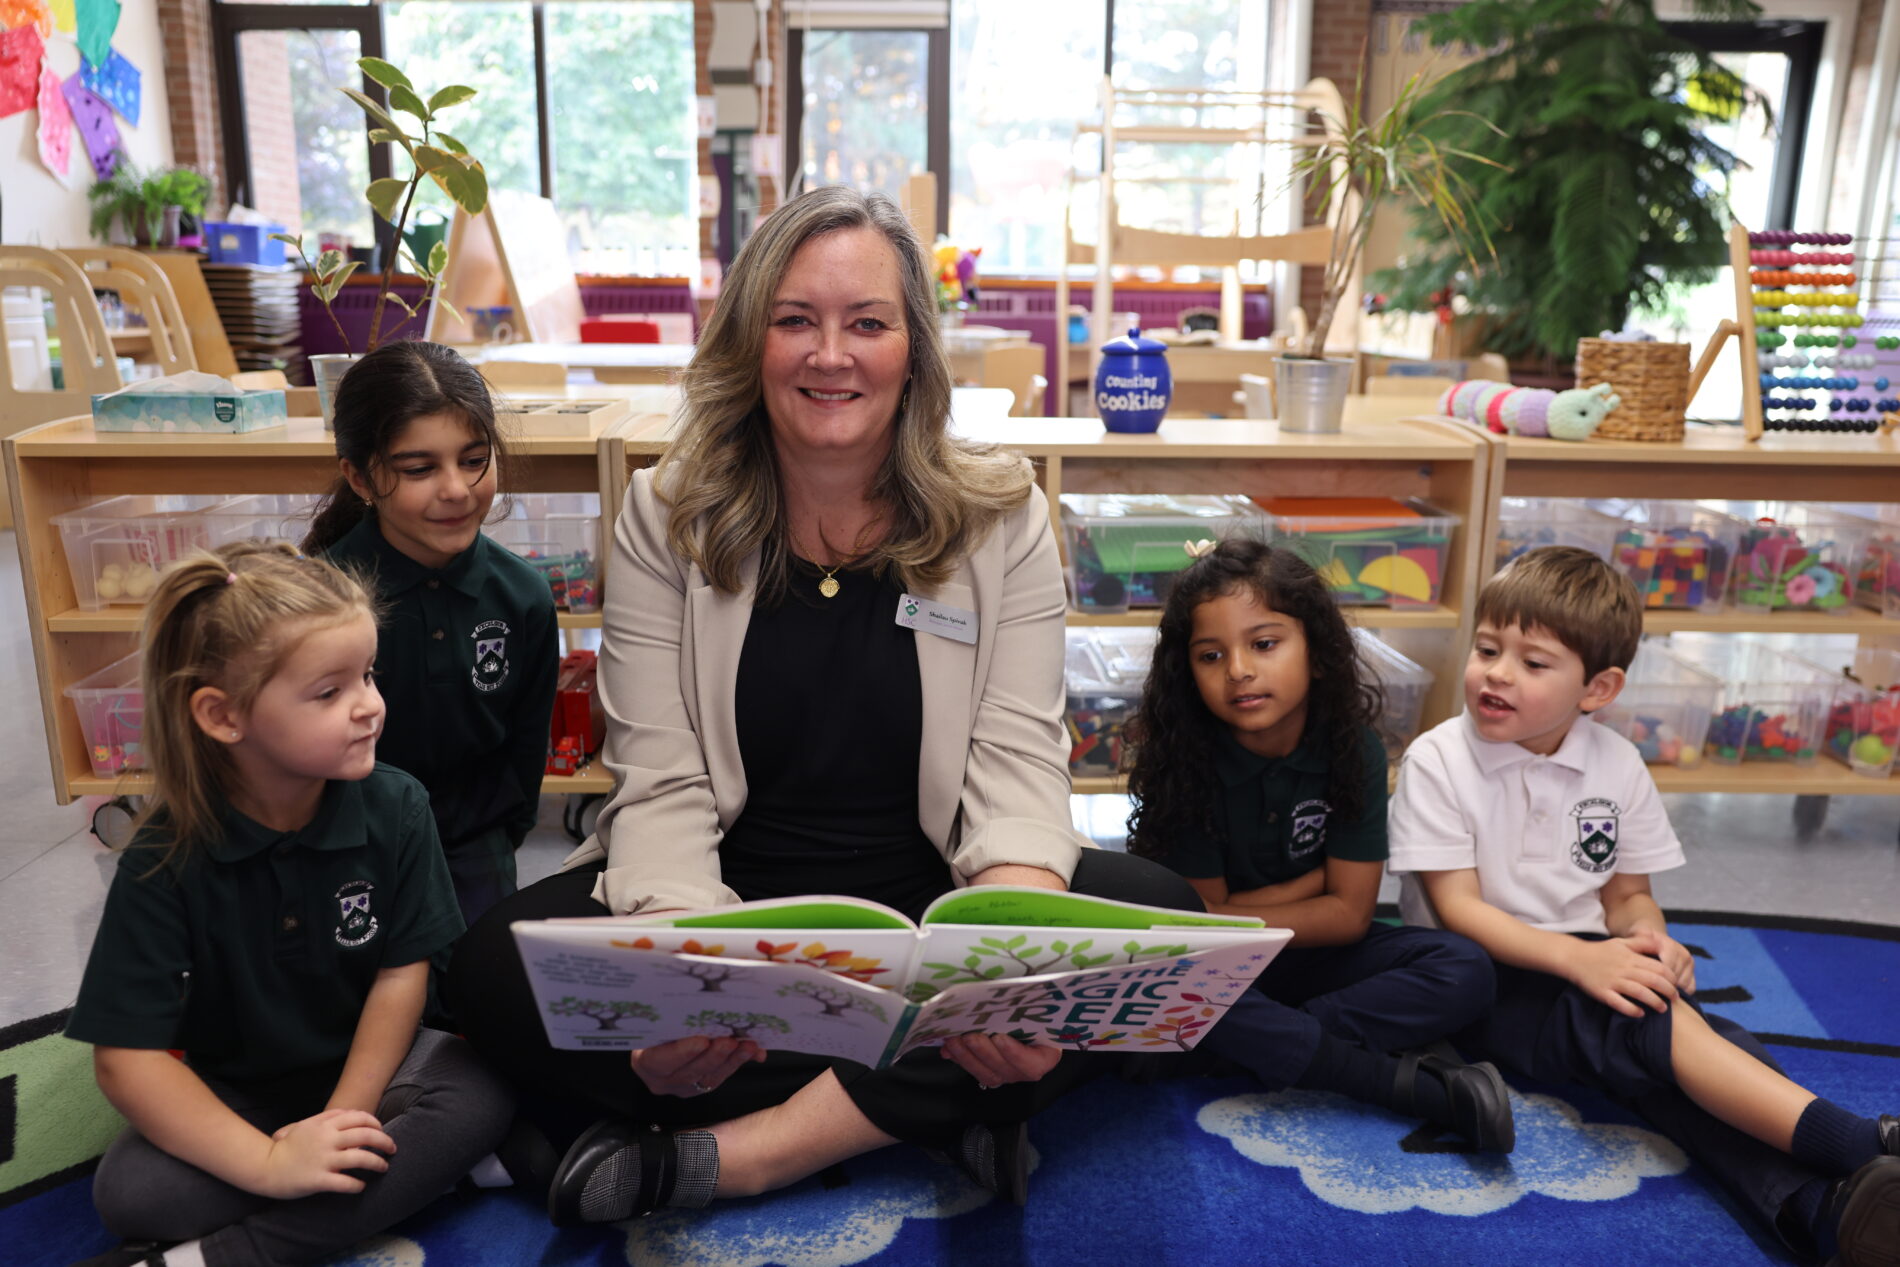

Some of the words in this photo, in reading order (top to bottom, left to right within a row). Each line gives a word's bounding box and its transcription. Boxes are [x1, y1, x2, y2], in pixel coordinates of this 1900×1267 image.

[1105, 374, 1157, 390] Counting
[1098, 390, 1167, 411] Cookies
[987, 972, 1111, 999] TAP
[1118, 965, 1194, 980] THE
[971, 980, 1179, 1012] MAGIC
[965, 1002, 1161, 1026] TREE
